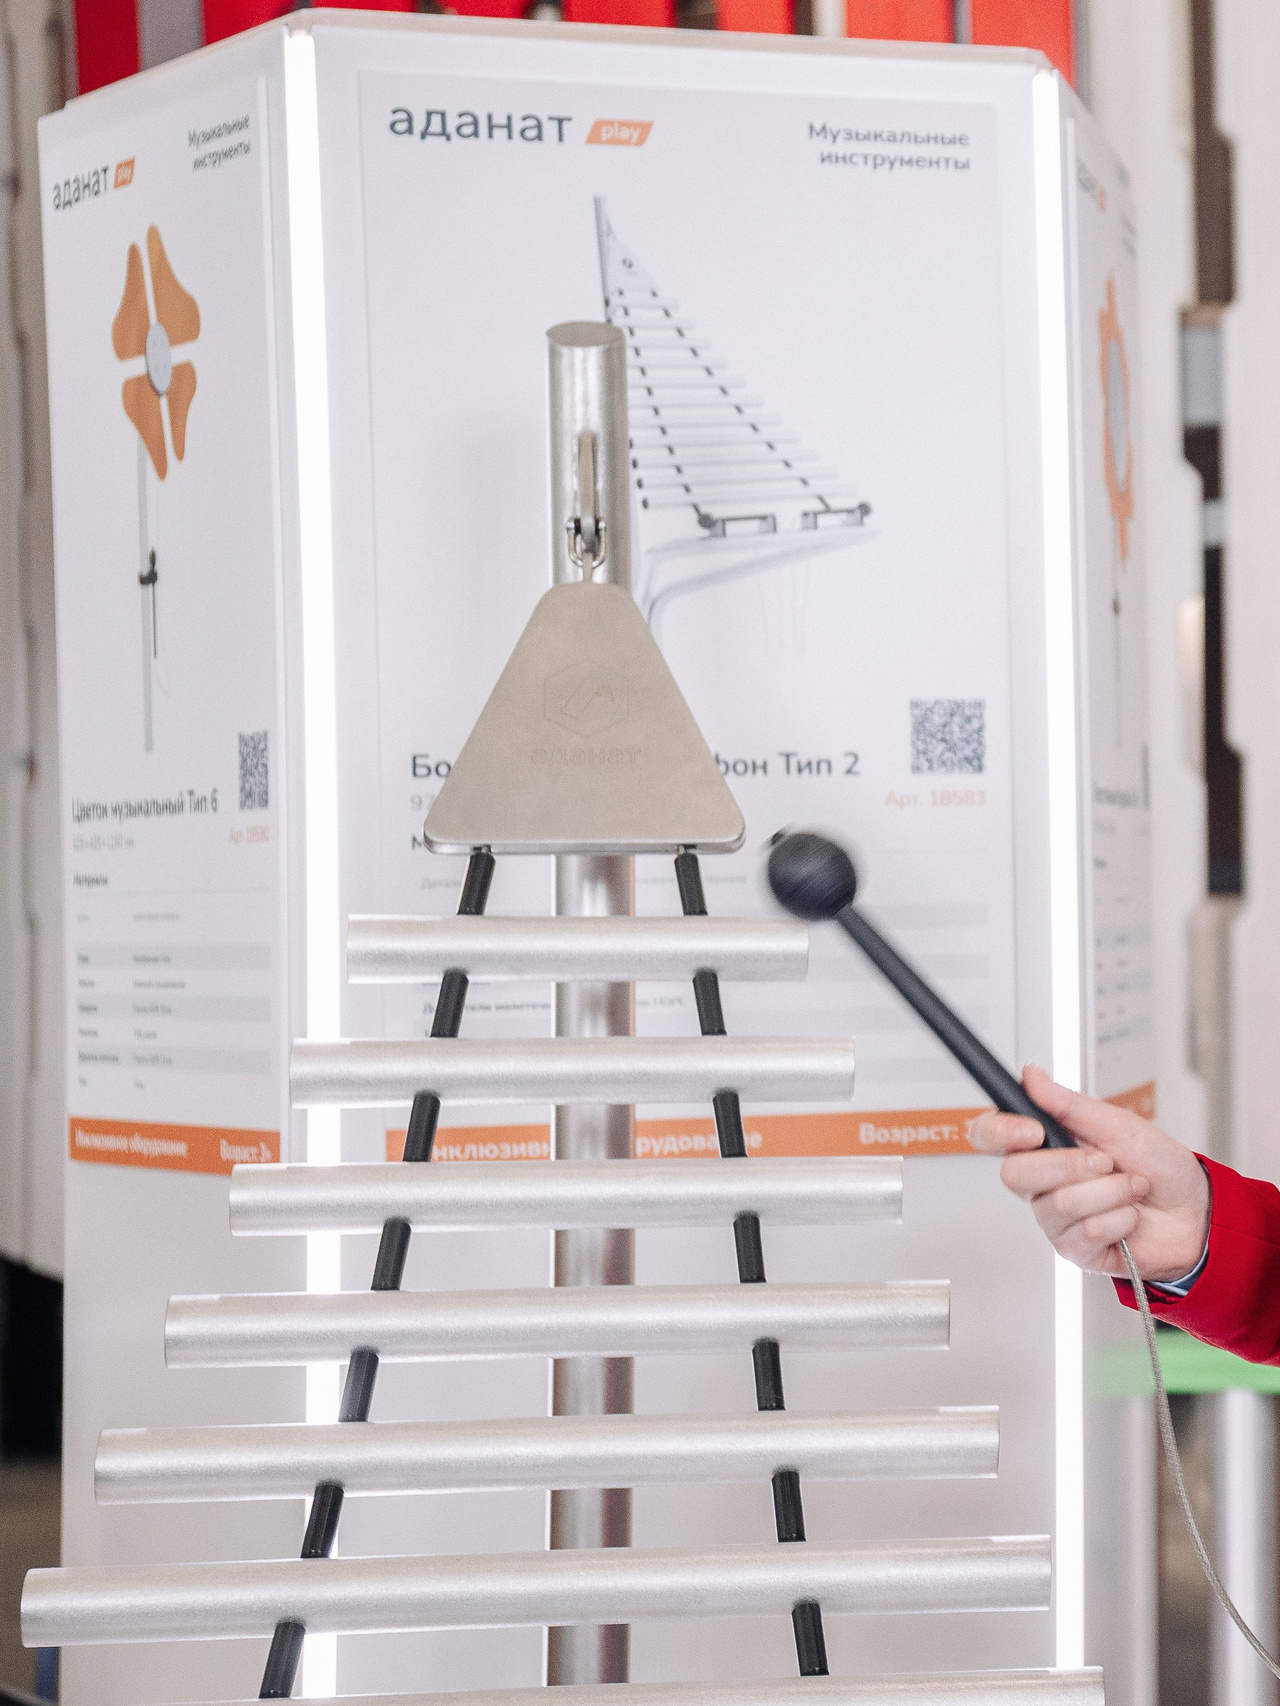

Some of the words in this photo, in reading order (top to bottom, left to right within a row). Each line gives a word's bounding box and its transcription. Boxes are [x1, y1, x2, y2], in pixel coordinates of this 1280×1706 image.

[188, 115, 250, 147] Музыкальные
[388, 106, 573, 143] аданат
[600, 122, 642, 144] play
[808, 122, 970, 145] Музыкальные
[193, 140, 251, 171] инструменты
[819, 151, 971, 171] инструменты
[53, 165, 109, 211] аданат
[411, 753, 451, 779] Бо
[715, 751, 769, 777] фон
[778, 751, 832, 776] Тип
[843, 751, 861, 776] 2
[72, 797, 108, 823] Цветок
[110, 791, 184, 823] музыкальный
[187, 788, 207, 813] Тип
[210, 786, 219, 813] 6
[432, 1141, 551, 1160] нклюзив
[859, 1122, 959, 1147] Возраст:
